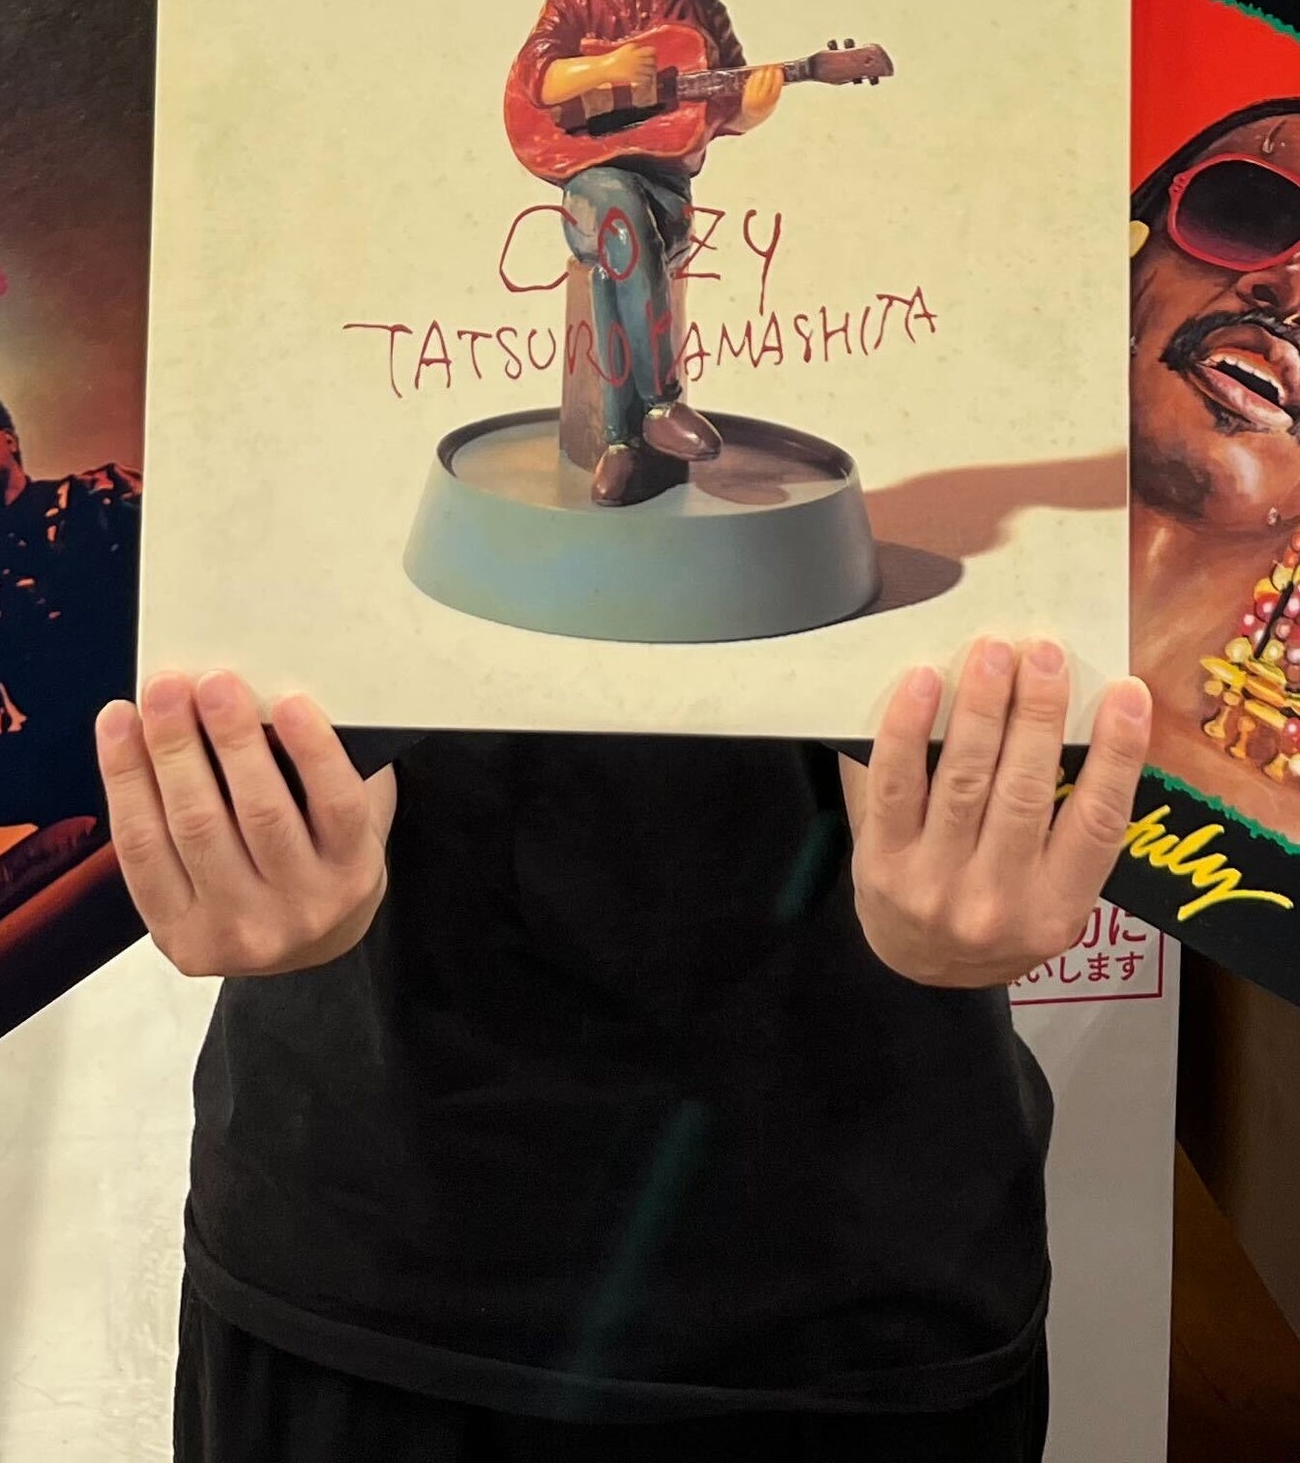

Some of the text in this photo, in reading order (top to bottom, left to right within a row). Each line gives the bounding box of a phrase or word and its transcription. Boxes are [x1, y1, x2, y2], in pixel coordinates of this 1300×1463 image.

[499, 205, 782, 314] COZY
[343, 286, 937, 397] TATSURO YAMASHITA
[1015, 950, 1146, 988] いします
